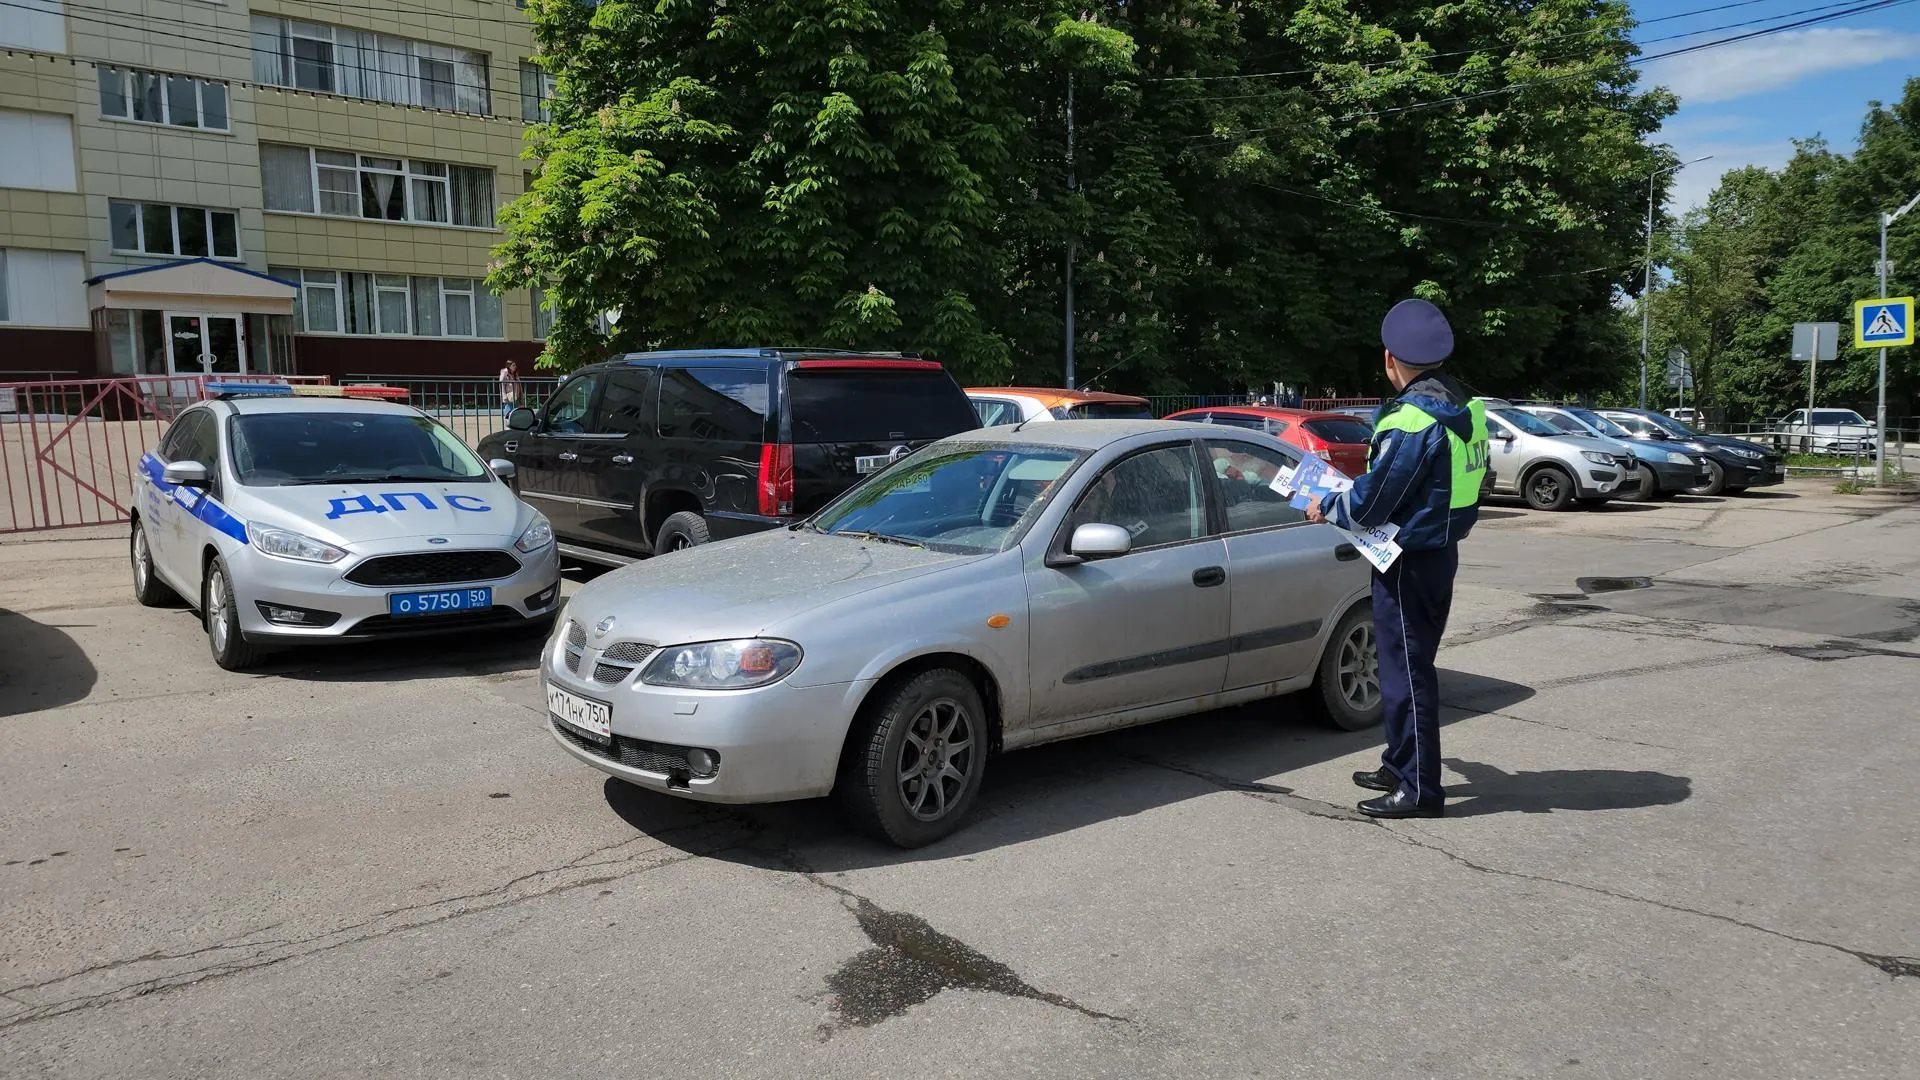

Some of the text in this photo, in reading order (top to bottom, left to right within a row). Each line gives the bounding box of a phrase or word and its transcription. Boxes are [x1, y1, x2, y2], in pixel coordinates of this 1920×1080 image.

[325, 492, 492, 520] ДПС
[418, 593, 460, 611] 5750
[470, 590, 486, 602] 50
[586, 702, 605, 724] 750
